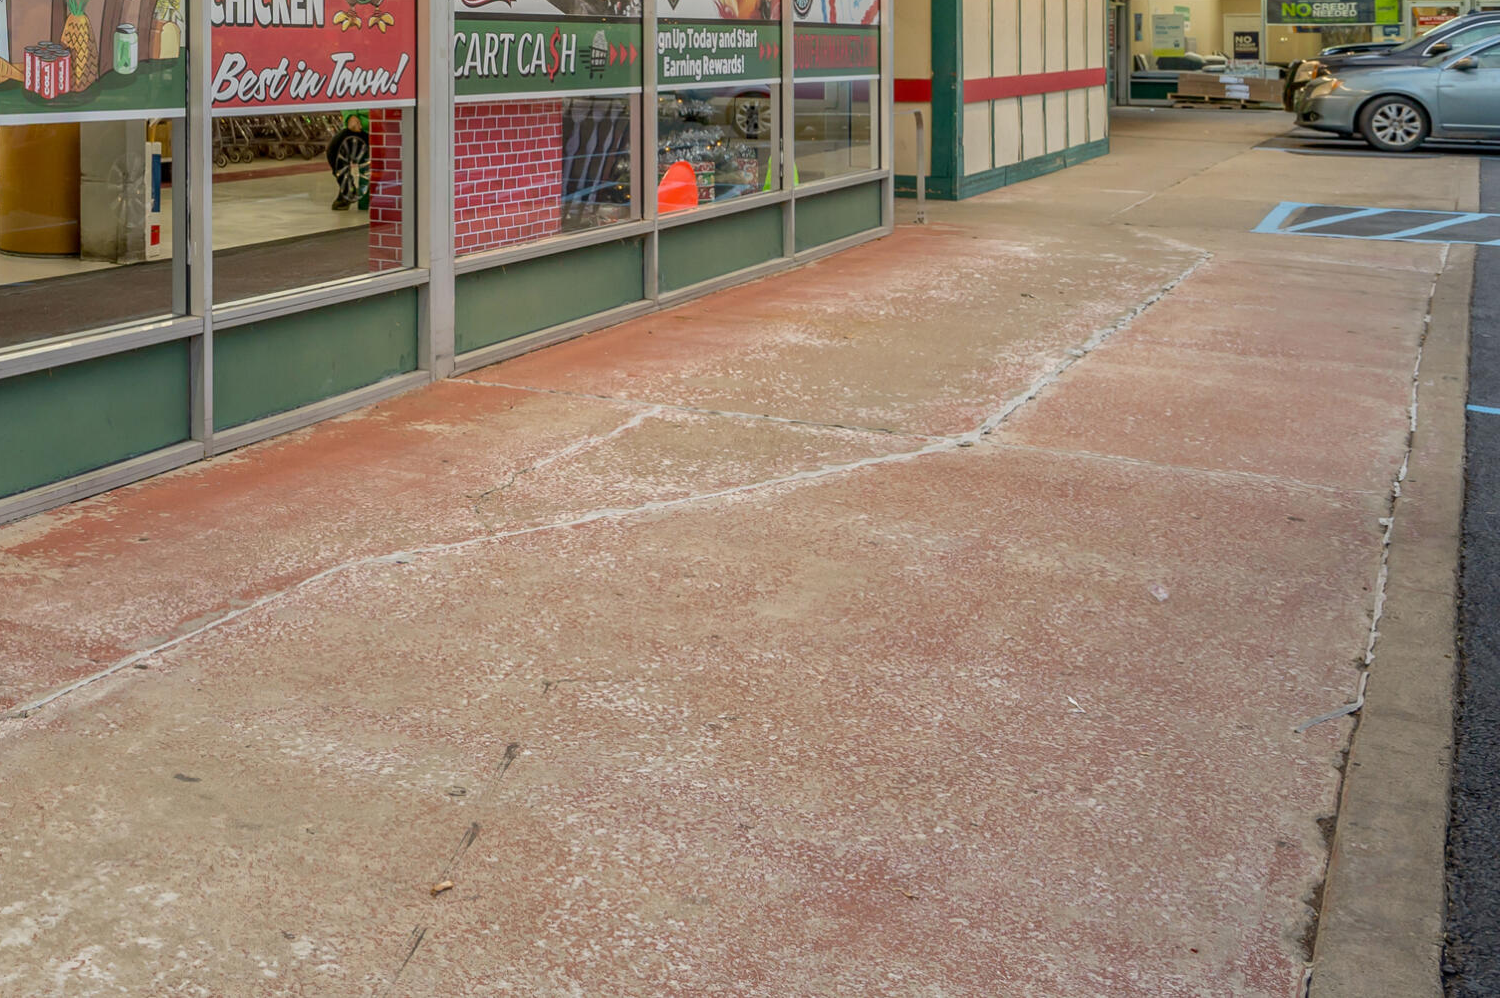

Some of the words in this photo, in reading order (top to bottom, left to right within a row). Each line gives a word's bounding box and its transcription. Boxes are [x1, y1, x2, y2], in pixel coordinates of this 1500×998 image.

[1281, 2, 1312, 17] NO
[1312, 2, 1358, 11] CREDIT
[657, 31, 672, 54] gn
[672, 28, 686, 53] Up
[687, 28, 718, 53] Today
[719, 28, 736, 48] and
[737, 28, 757, 48] Start
[1236, 35, 1252, 43] NO
[453, 32, 515, 77] CART
[517, 26, 576, 82] CA$H
[663, 54, 702, 81] Earning
[703, 53, 744, 75] Rewards!
[211, 51, 290, 104] Best
[289, 60, 327, 100] in
[326, 52, 409, 99] Town!
